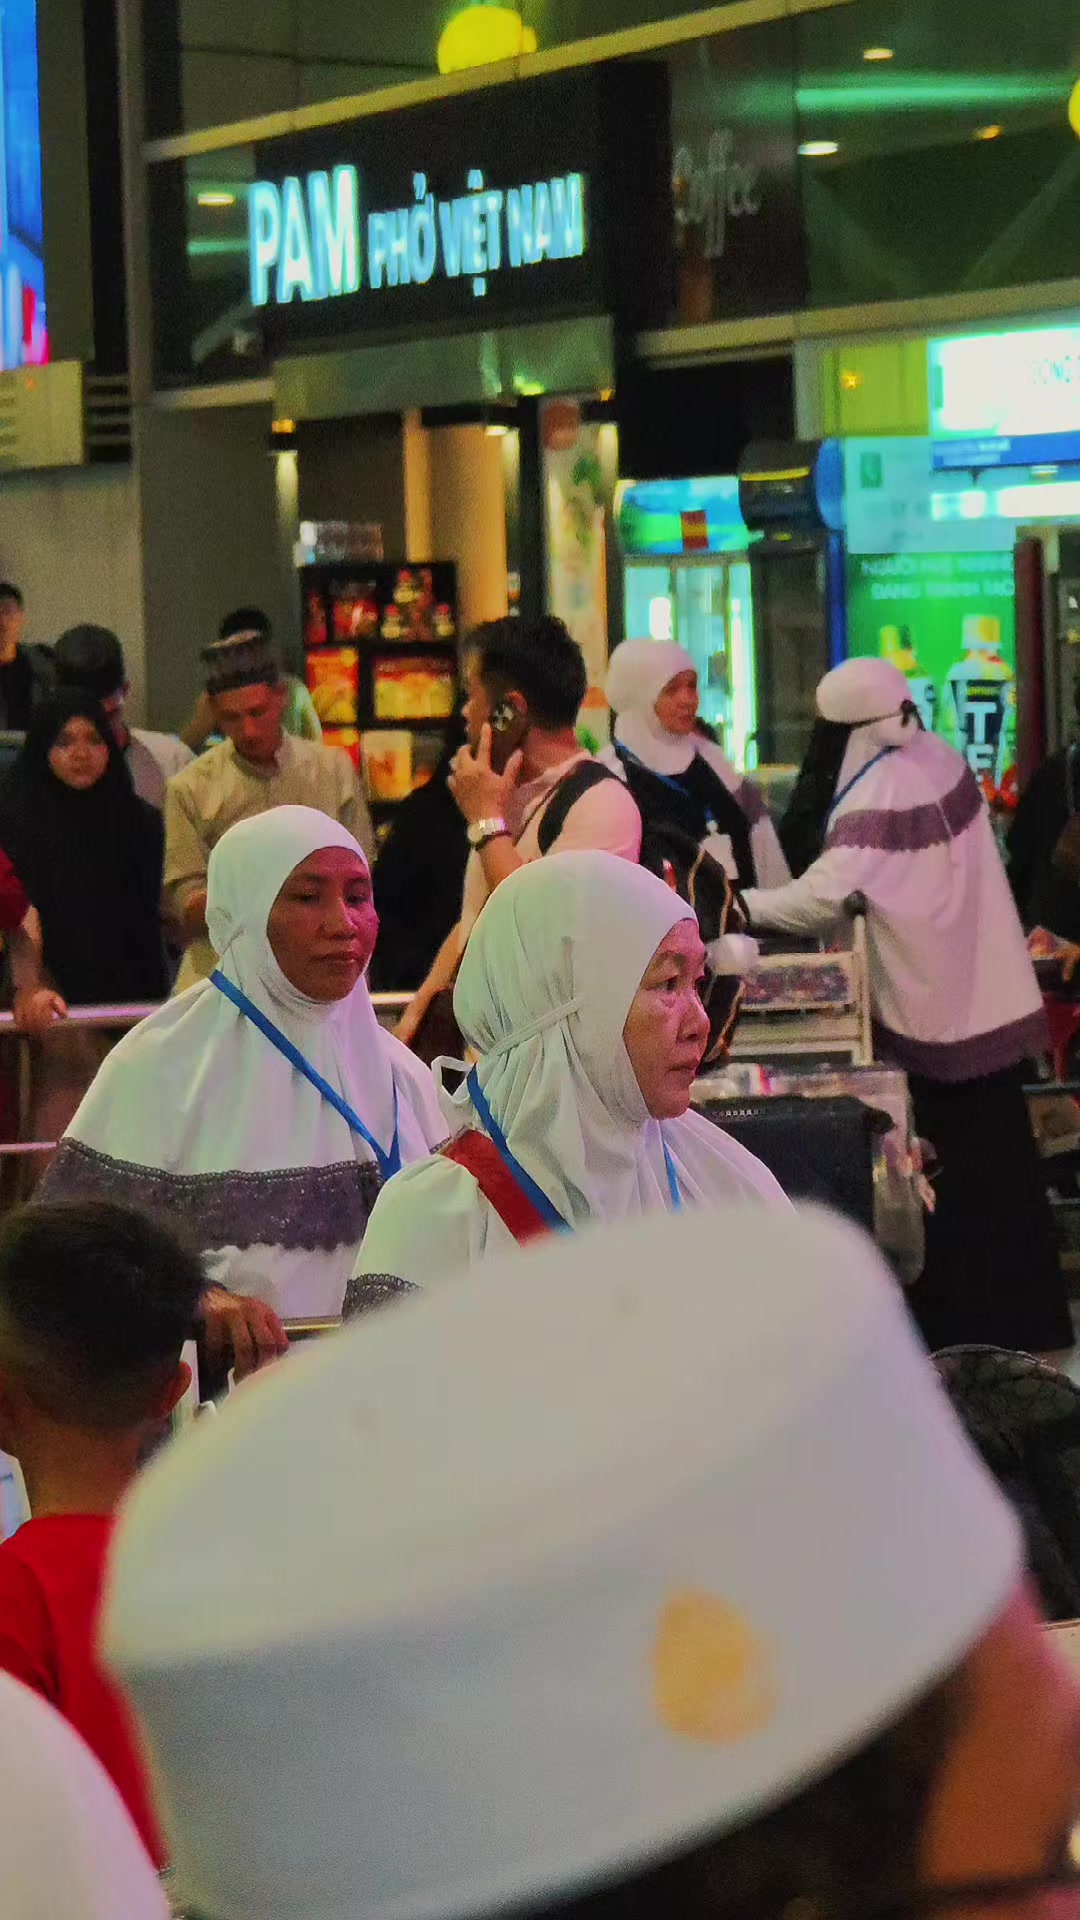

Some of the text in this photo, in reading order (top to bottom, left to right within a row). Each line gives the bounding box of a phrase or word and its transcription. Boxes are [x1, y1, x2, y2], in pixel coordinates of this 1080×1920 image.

[250, 164, 584, 306] PAM PHỞ VIỆT NAM
